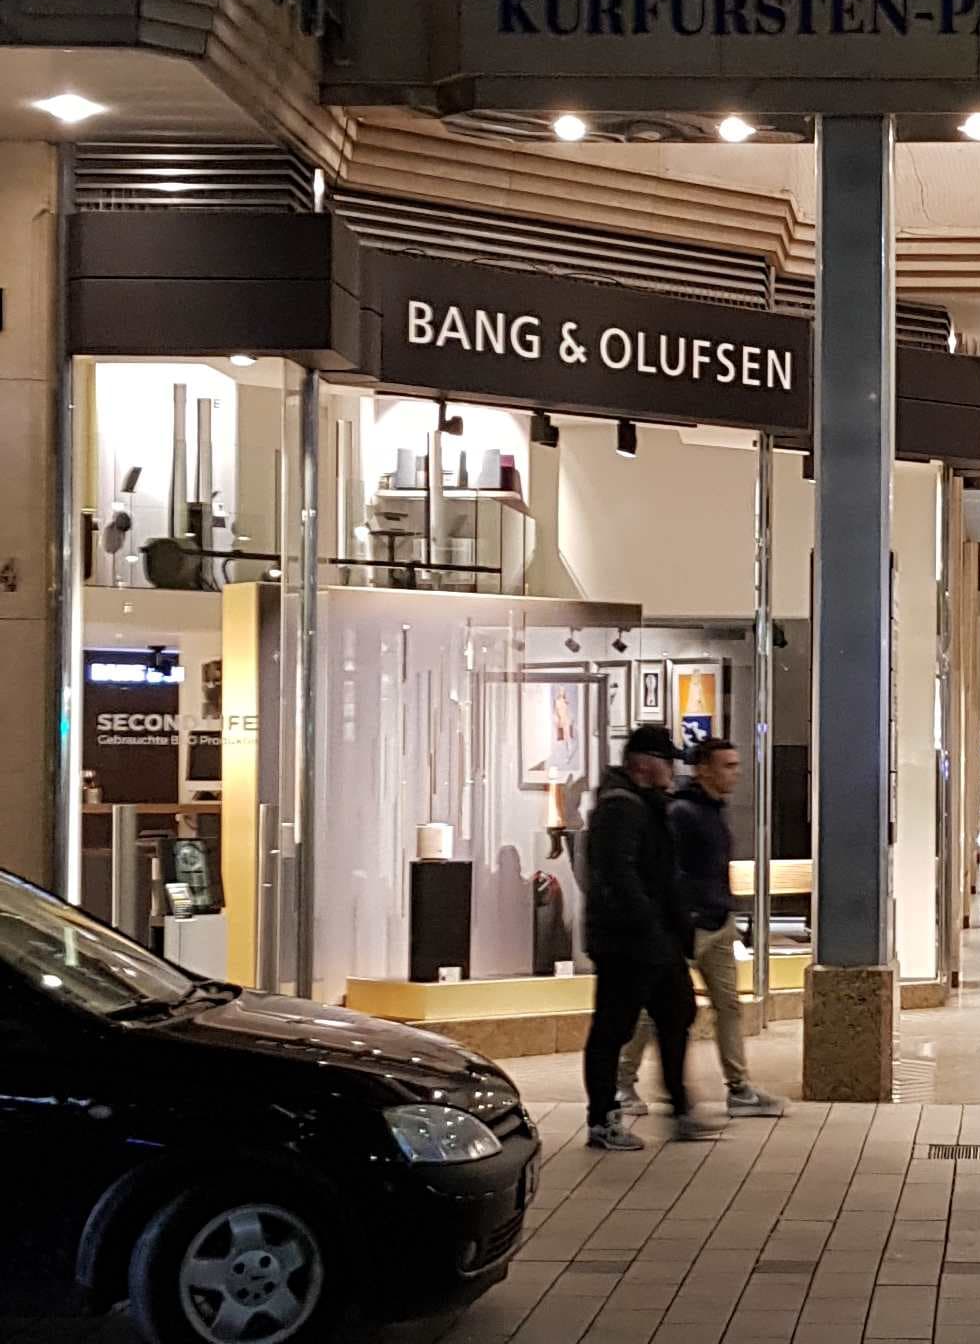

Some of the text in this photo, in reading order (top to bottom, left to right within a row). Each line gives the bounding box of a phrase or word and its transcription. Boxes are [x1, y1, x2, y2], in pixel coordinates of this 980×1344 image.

[408, 300, 793, 390] BANG & OLUFSEN
[96, 734, 169, 745] Gebrauchte
[170, 735, 199, 746] BO
